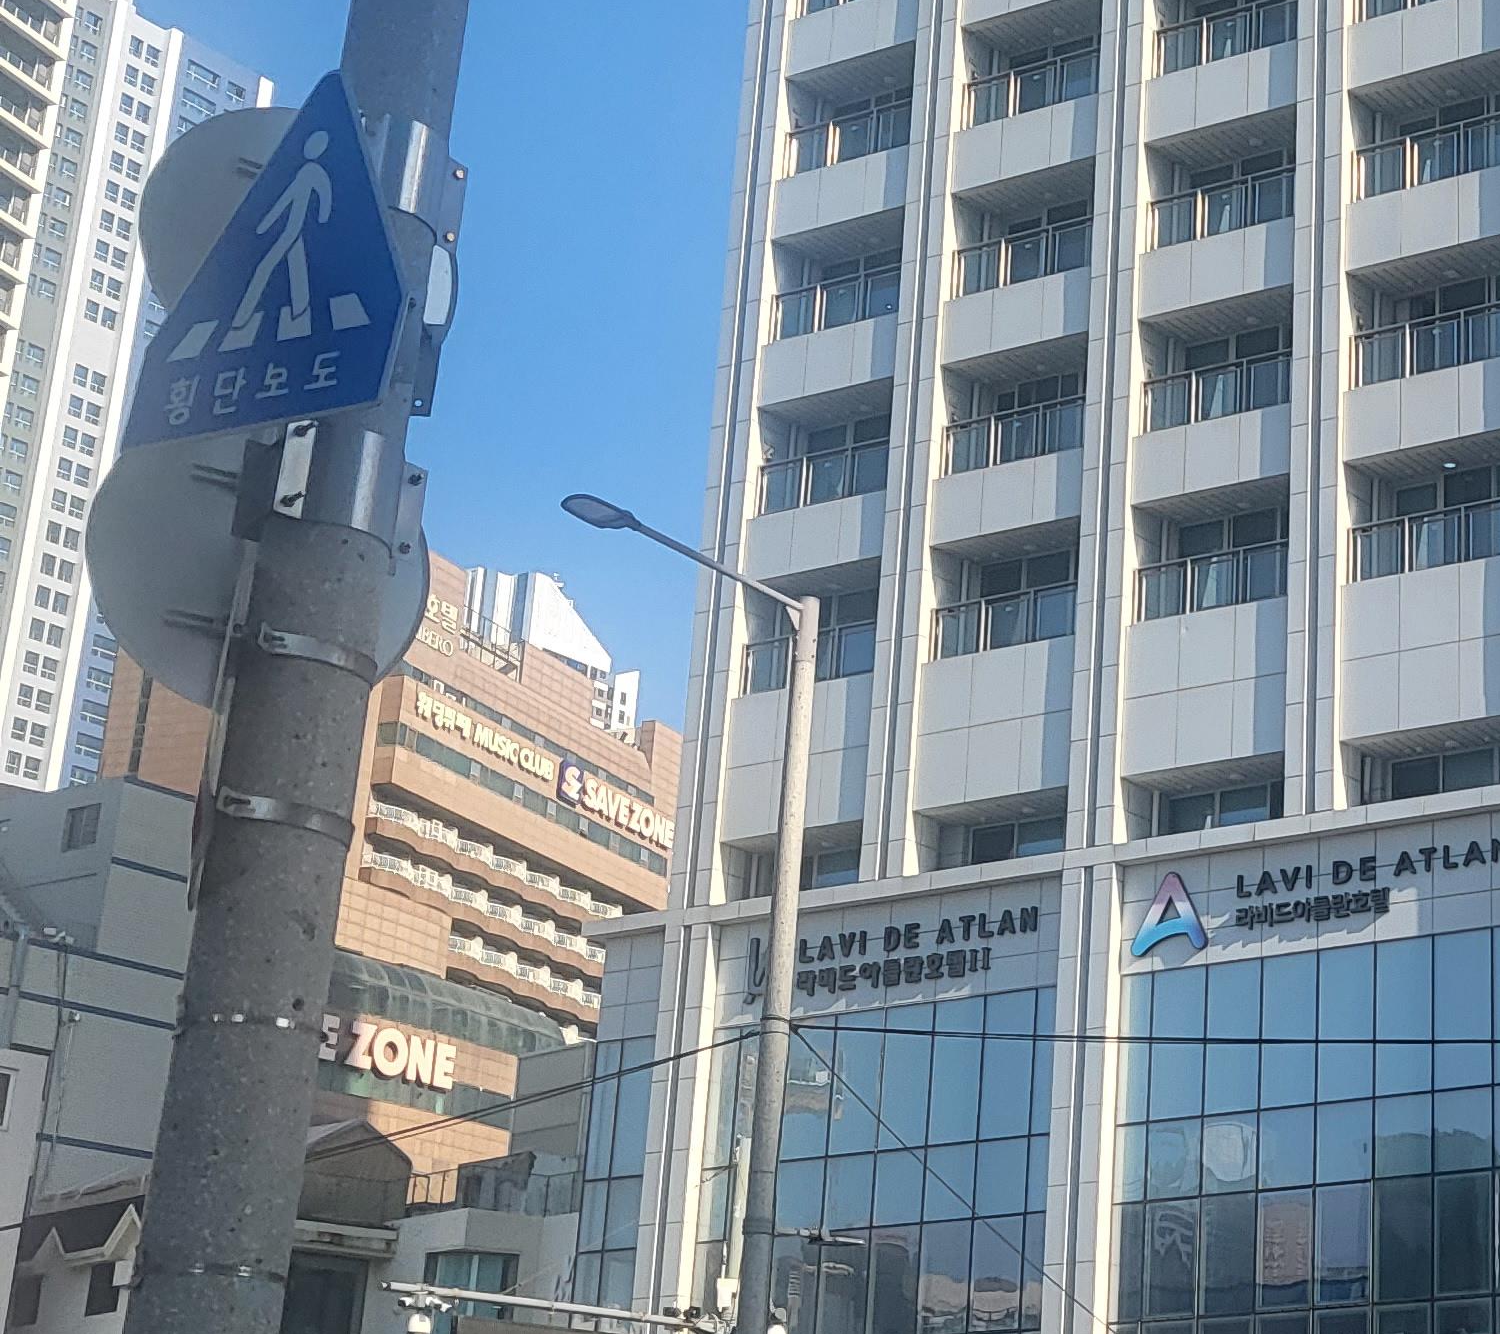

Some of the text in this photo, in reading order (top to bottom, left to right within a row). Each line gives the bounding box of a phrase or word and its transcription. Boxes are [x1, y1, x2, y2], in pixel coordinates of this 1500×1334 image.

[165, 351, 341, 426] 횡단보도
[473, 722, 520, 767] MUSIC
[519, 748, 555, 782] CLUB
[1236, 864, 1313, 899] LAVI
[1331, 855, 1377, 886] DE
[798, 905, 1039, 964] LAVI DE ATLAN
[1234, 886, 1391, 931] 라비드아틀란호텔
[344, 1021, 457, 1090] ZONE
